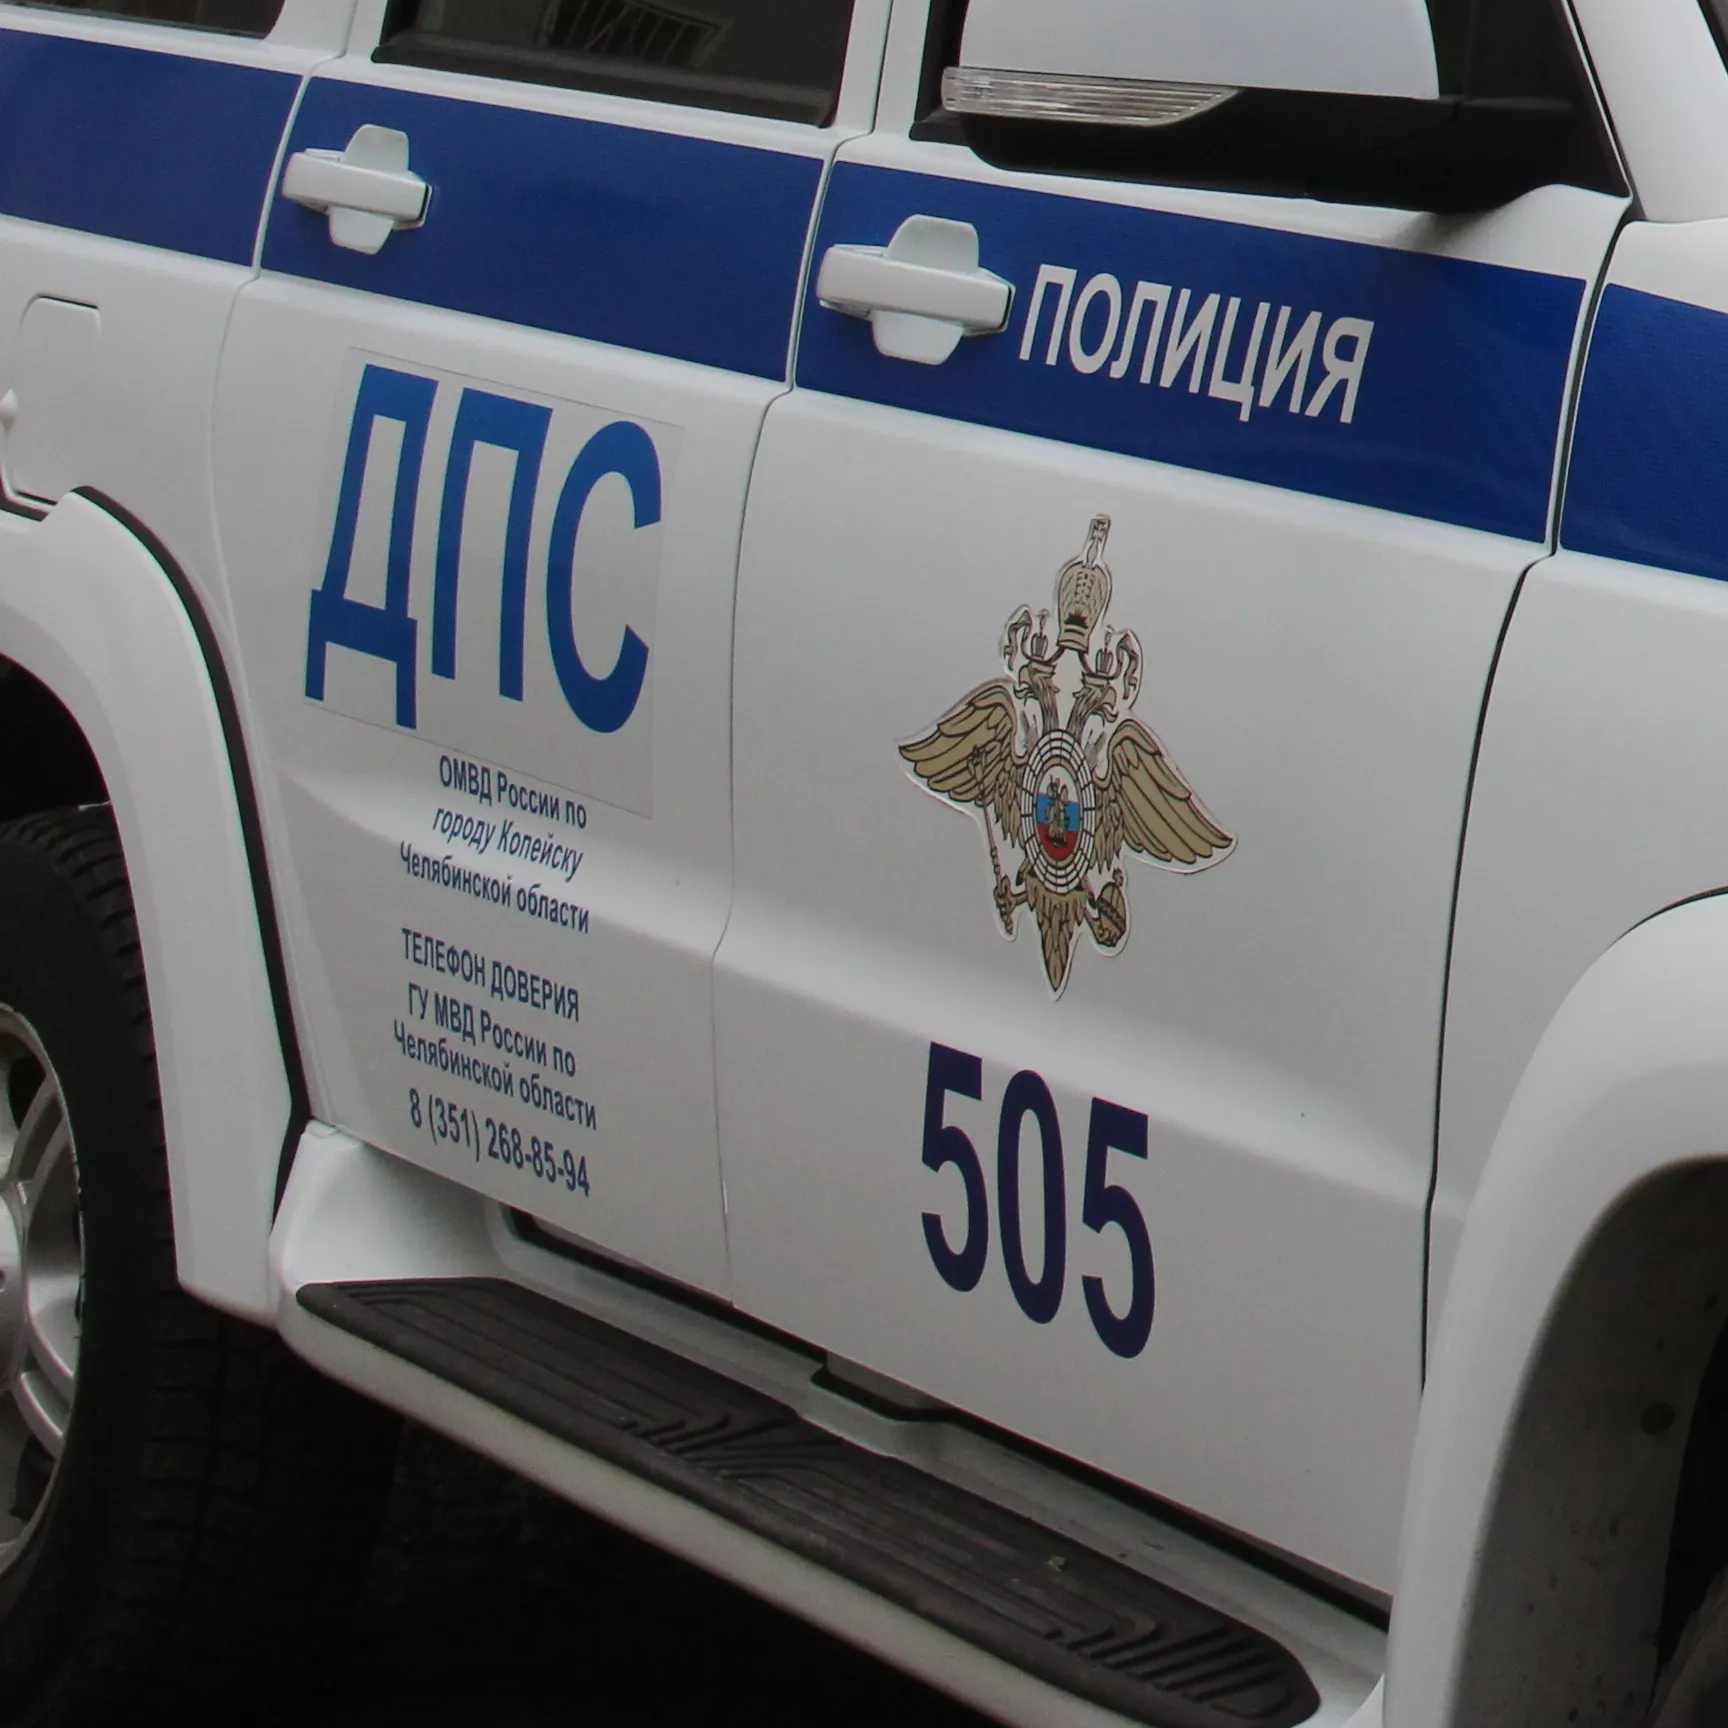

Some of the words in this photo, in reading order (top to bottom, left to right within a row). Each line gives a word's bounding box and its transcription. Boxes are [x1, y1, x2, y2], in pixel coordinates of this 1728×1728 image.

[1019, 264, 1374, 423] ПОЛИЦИЯ
[305, 363, 662, 733] ДПС
[439, 755, 492, 806] ОМВД
[497, 770, 559, 821] России
[565, 800, 587, 829] по
[400, 840, 512, 907] Челябинской
[517, 883, 589, 934] области
[432, 808, 496, 854] городу
[497, 819, 584, 883] Копейску
[402, 927, 486, 988] ТЕЛЕФОН
[491, 960, 579, 1022] ДОВЕРИЯ
[394, 1020, 514, 1097] Челябинской
[519, 1073, 597, 1130] области
[408, 982, 429, 1020] ГУ
[434, 992, 476, 1046] МВД
[480, 1009, 547, 1067] России
[553, 1045, 576, 1077] по
[409, 1088, 422, 1129] 8
[428, 1094, 481, 1162] (351)
[485, 1117, 590, 1198] 268-85-94
[921, 1041, 1155, 1359] 505
